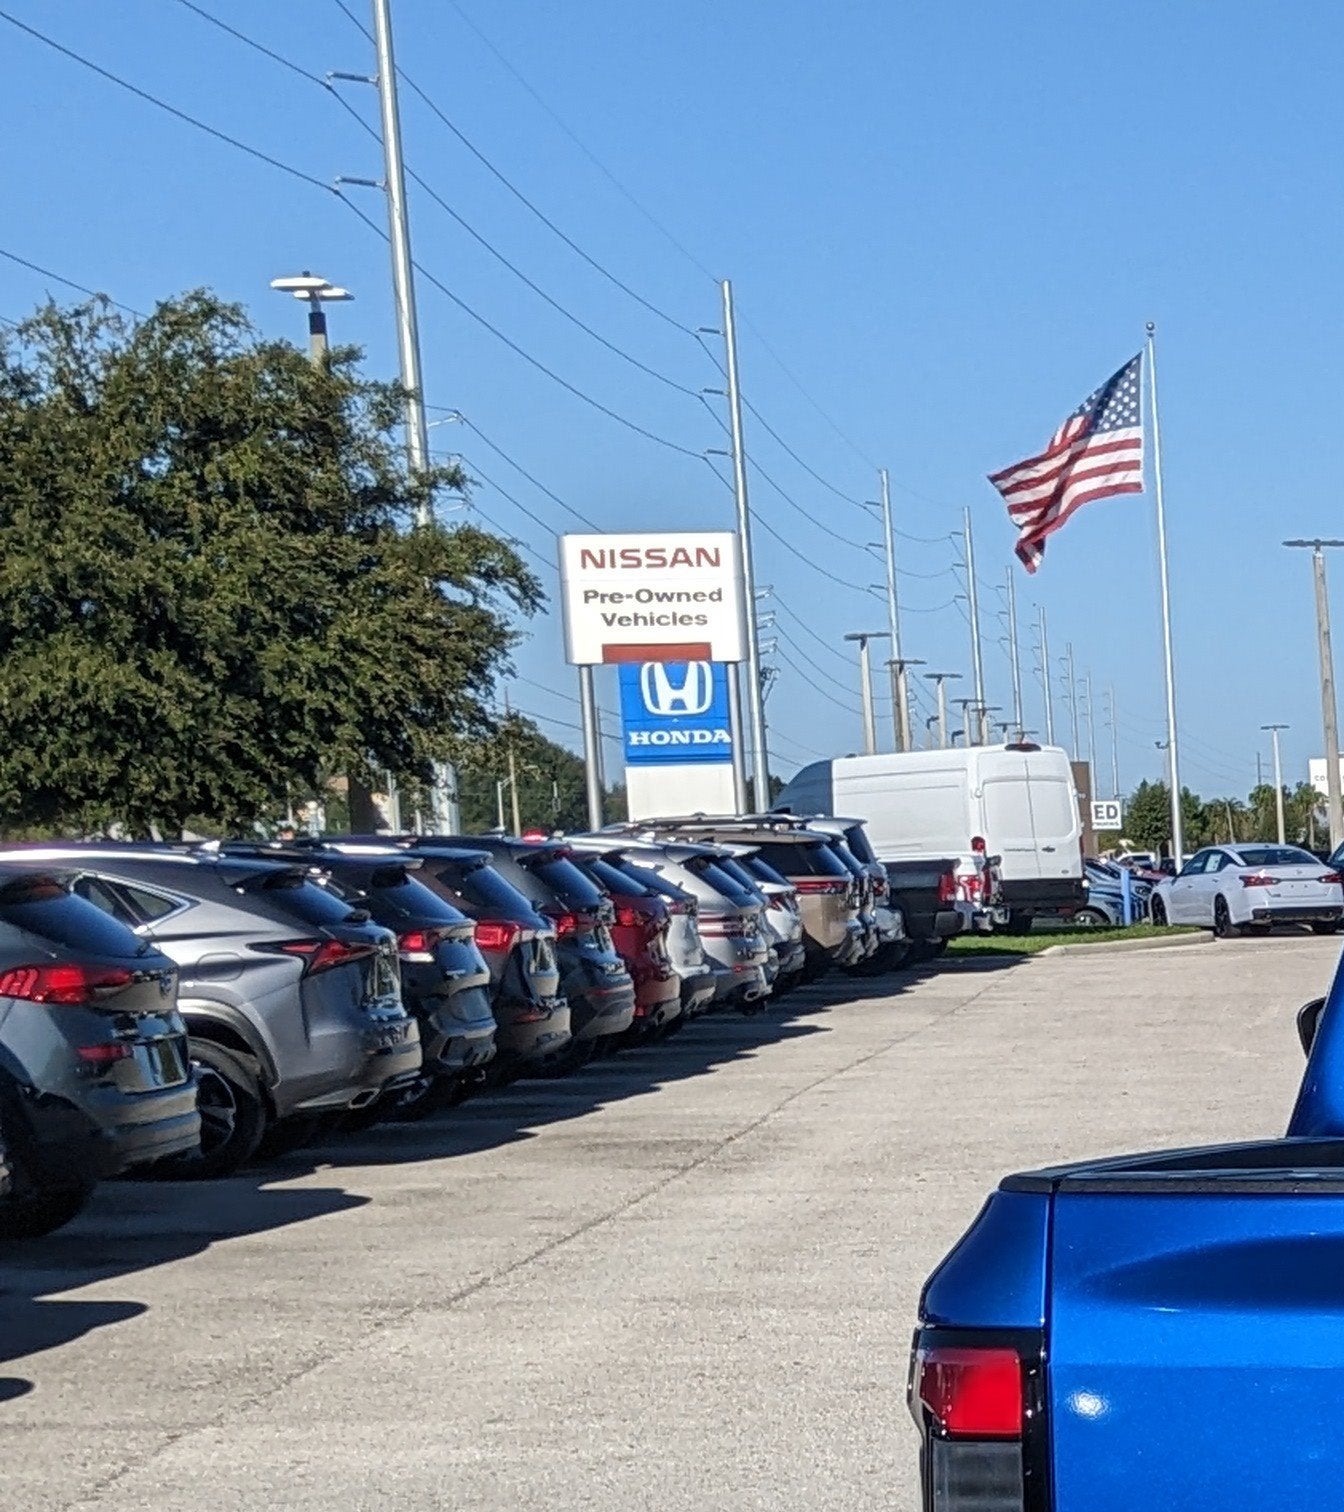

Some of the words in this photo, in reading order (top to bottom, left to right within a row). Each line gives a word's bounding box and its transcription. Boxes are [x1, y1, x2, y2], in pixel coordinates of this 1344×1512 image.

[580, 547, 721, 570] NISSAN
[583, 587, 723, 604] Pre-Owned
[601, 611, 708, 627] Vehicles
[629, 728, 732, 746] HONDA
